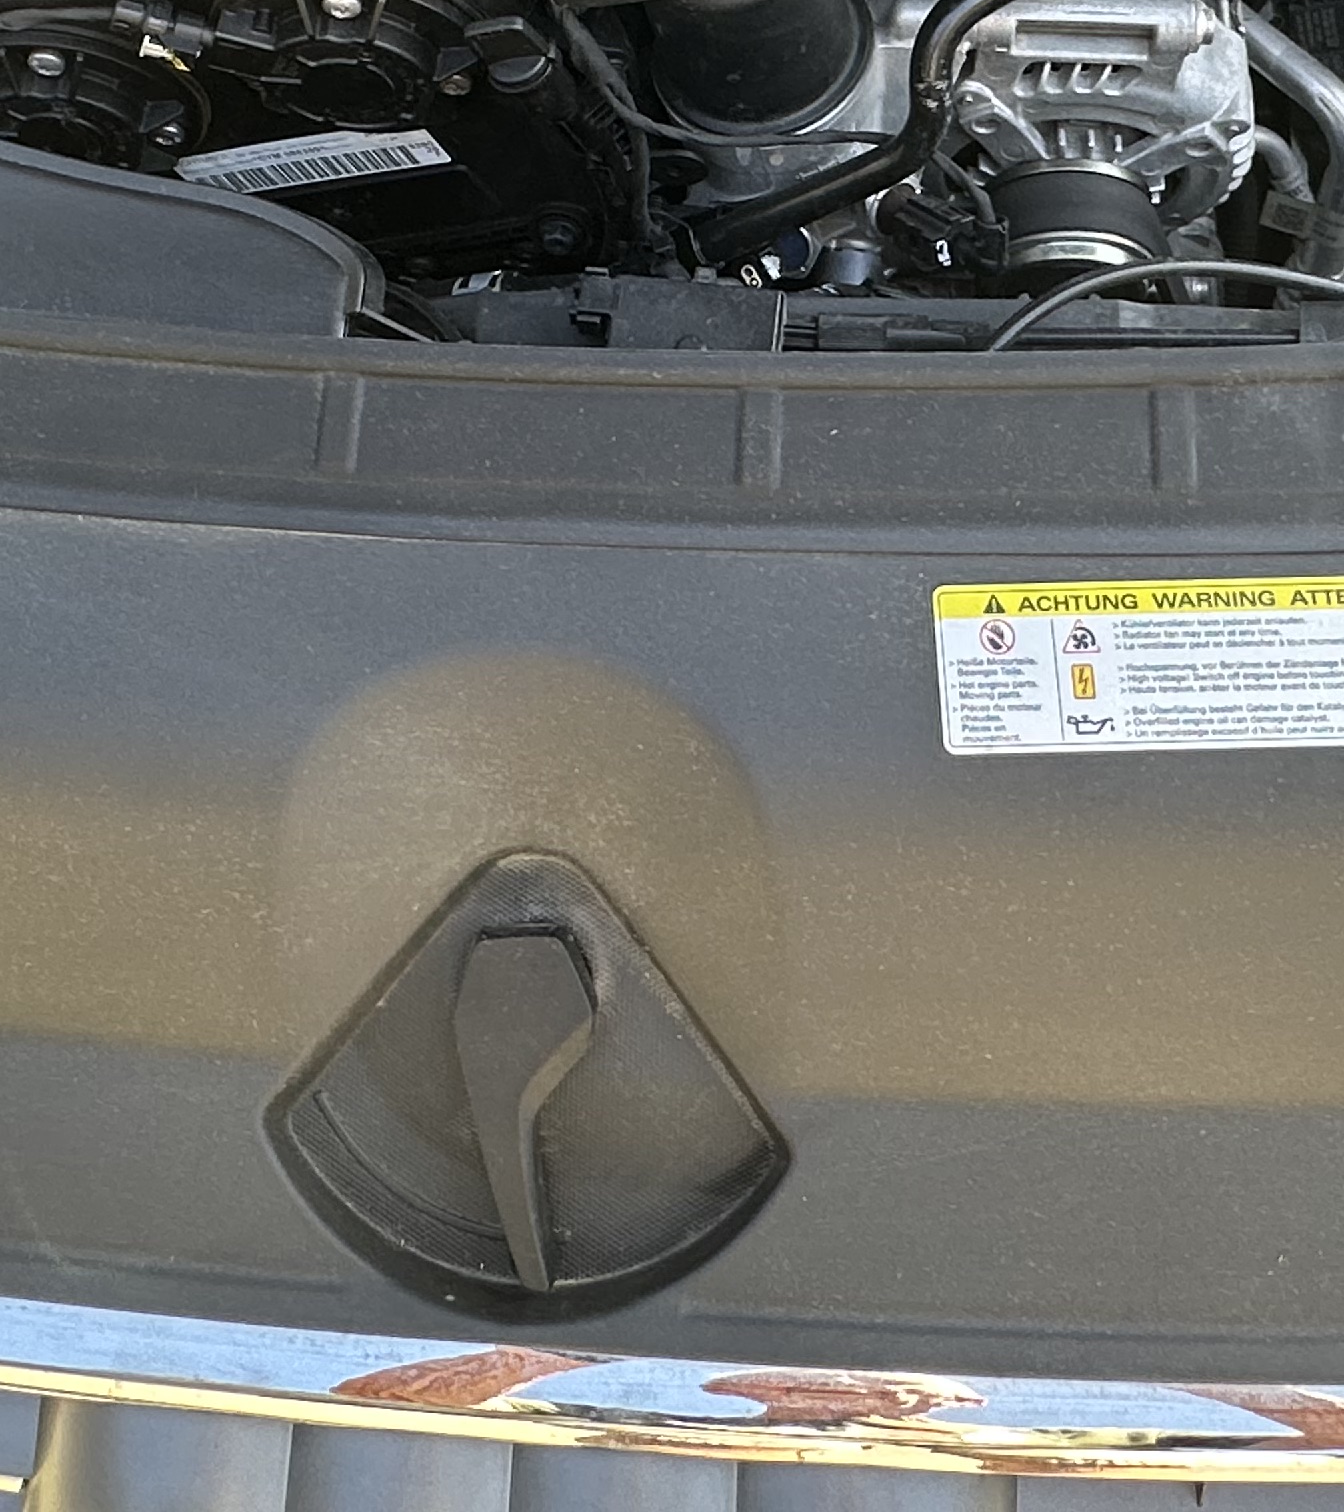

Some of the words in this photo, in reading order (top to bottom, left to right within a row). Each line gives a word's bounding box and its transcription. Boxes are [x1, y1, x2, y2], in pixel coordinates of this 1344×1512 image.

[1018, 593, 1138, 612] ACHTUNG
[1152, 590, 1276, 609] WARNING
[959, 681, 975, 689] Hot
[978, 682, 1010, 690] engine
[1012, 680, 1039, 689] parts.
[959, 691, 995, 701] Moving
